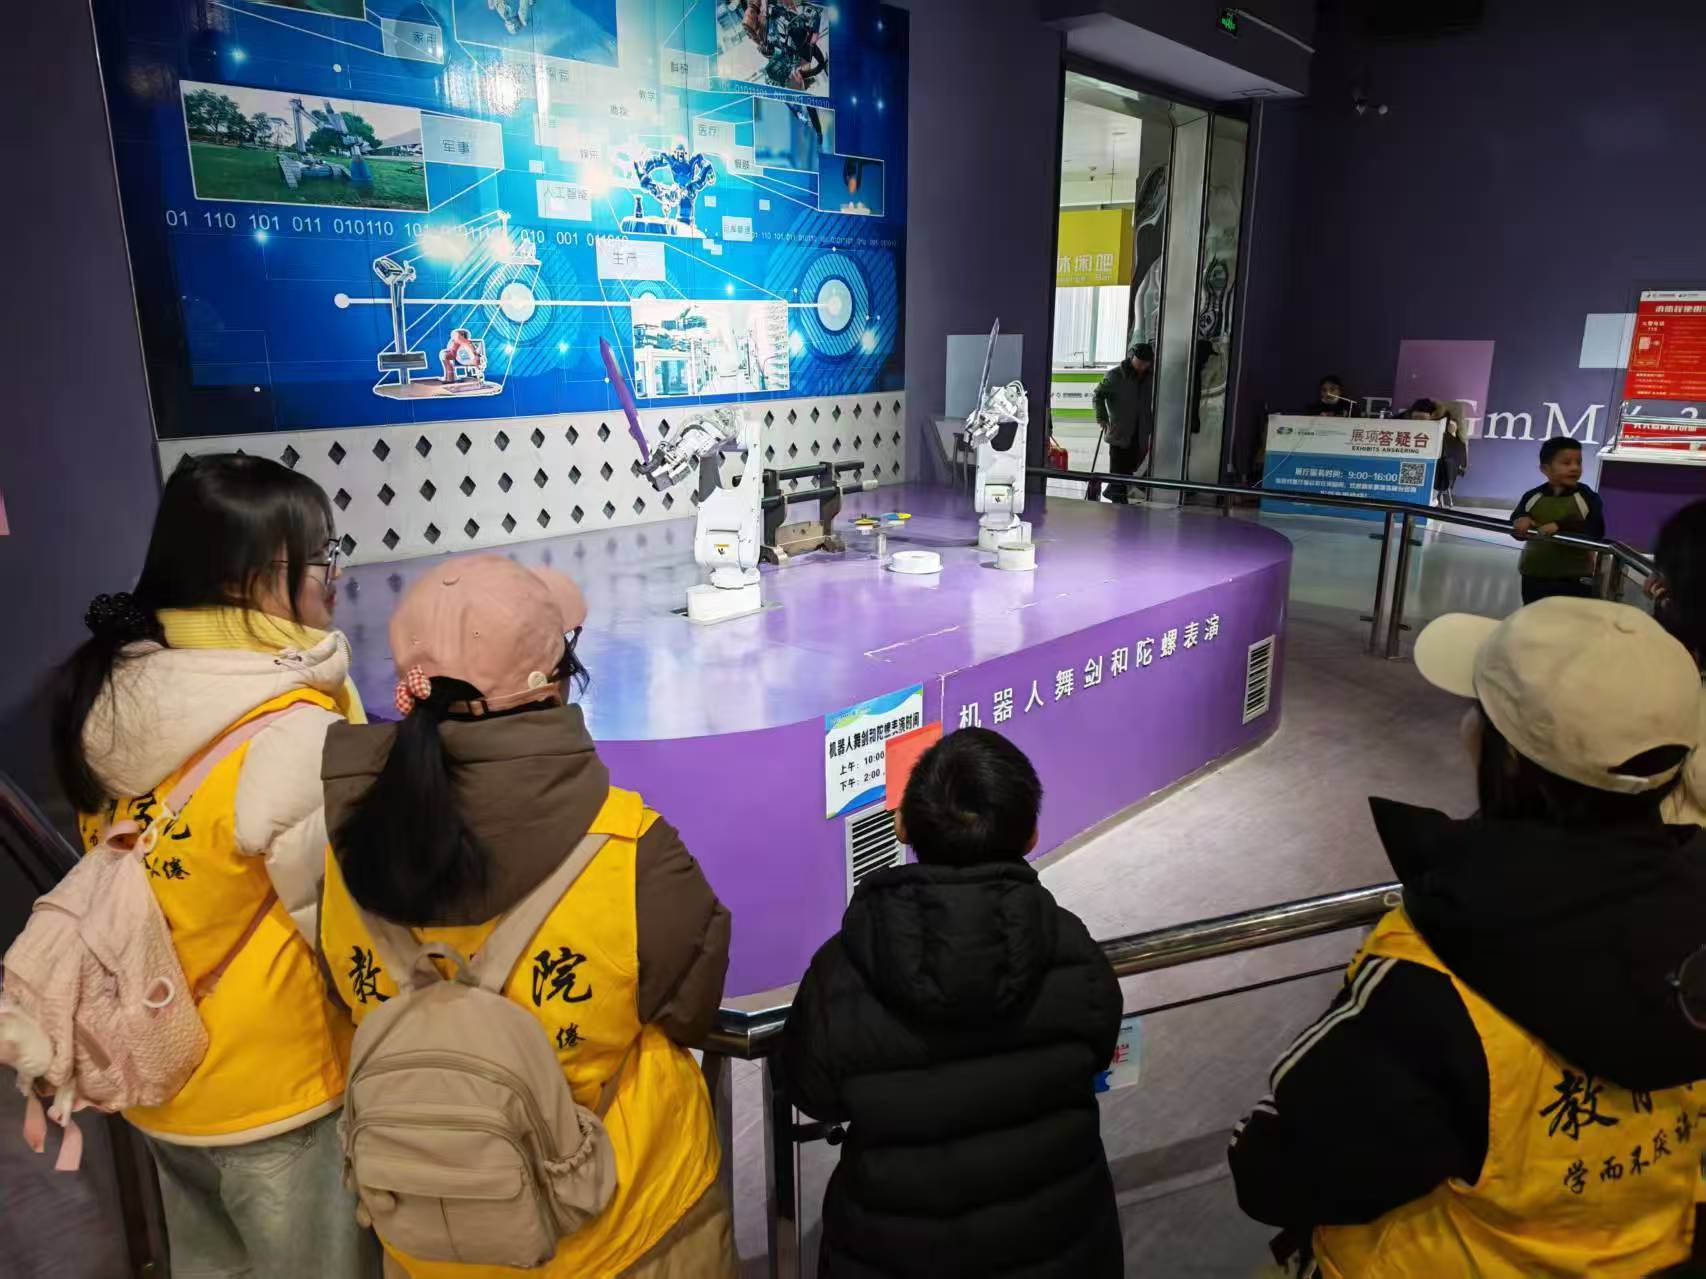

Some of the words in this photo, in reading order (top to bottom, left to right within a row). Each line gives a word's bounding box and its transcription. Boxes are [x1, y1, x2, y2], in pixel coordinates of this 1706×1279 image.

[441, 138, 471, 155] 军事
[543, 184, 589, 201] 人工智能
[166, 209, 188, 227] 01
[203, 211, 236, 229] 110
[249, 213, 280, 231] 101
[292, 215, 321, 233] 011
[333, 218, 394, 236] 010110
[556, 230, 579, 246] 001
[611, 251, 639, 266] 生产
[1350, 428, 1430, 449] 展项答疑台
[959, 614, 1220, 729] 机器人舞剑和陀螺表演
[829, 711, 920, 759] 机器人舞剑和陀螺表演时间
[864, 768, 881, 783] 2:00
[532, 946, 593, 1007] 院
[1539, 1067, 1620, 1141] 教
